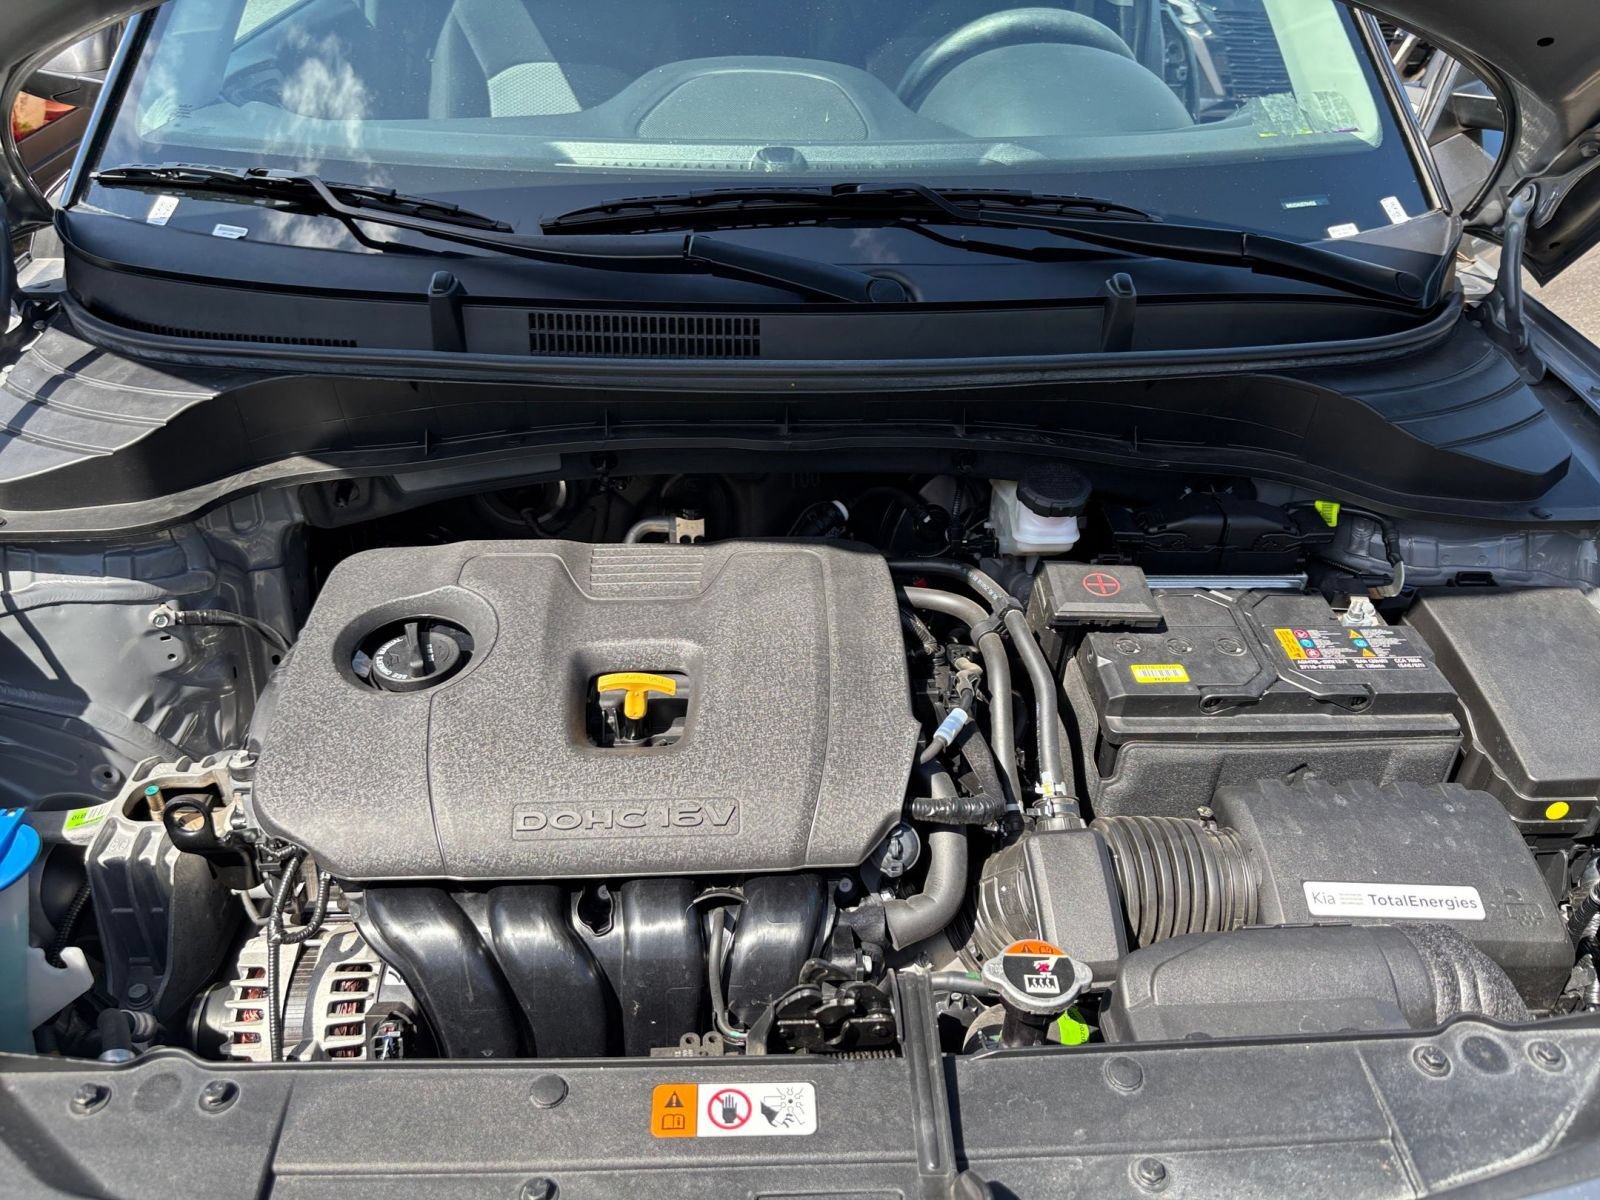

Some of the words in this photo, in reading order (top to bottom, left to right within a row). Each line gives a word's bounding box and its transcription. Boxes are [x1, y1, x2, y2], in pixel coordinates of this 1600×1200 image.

[515, 809, 648, 832] DOHC
[658, 804, 737, 828] 16V
[1311, 891, 1336, 905] Kia
[1368, 893, 1478, 910] TotalEnergies
